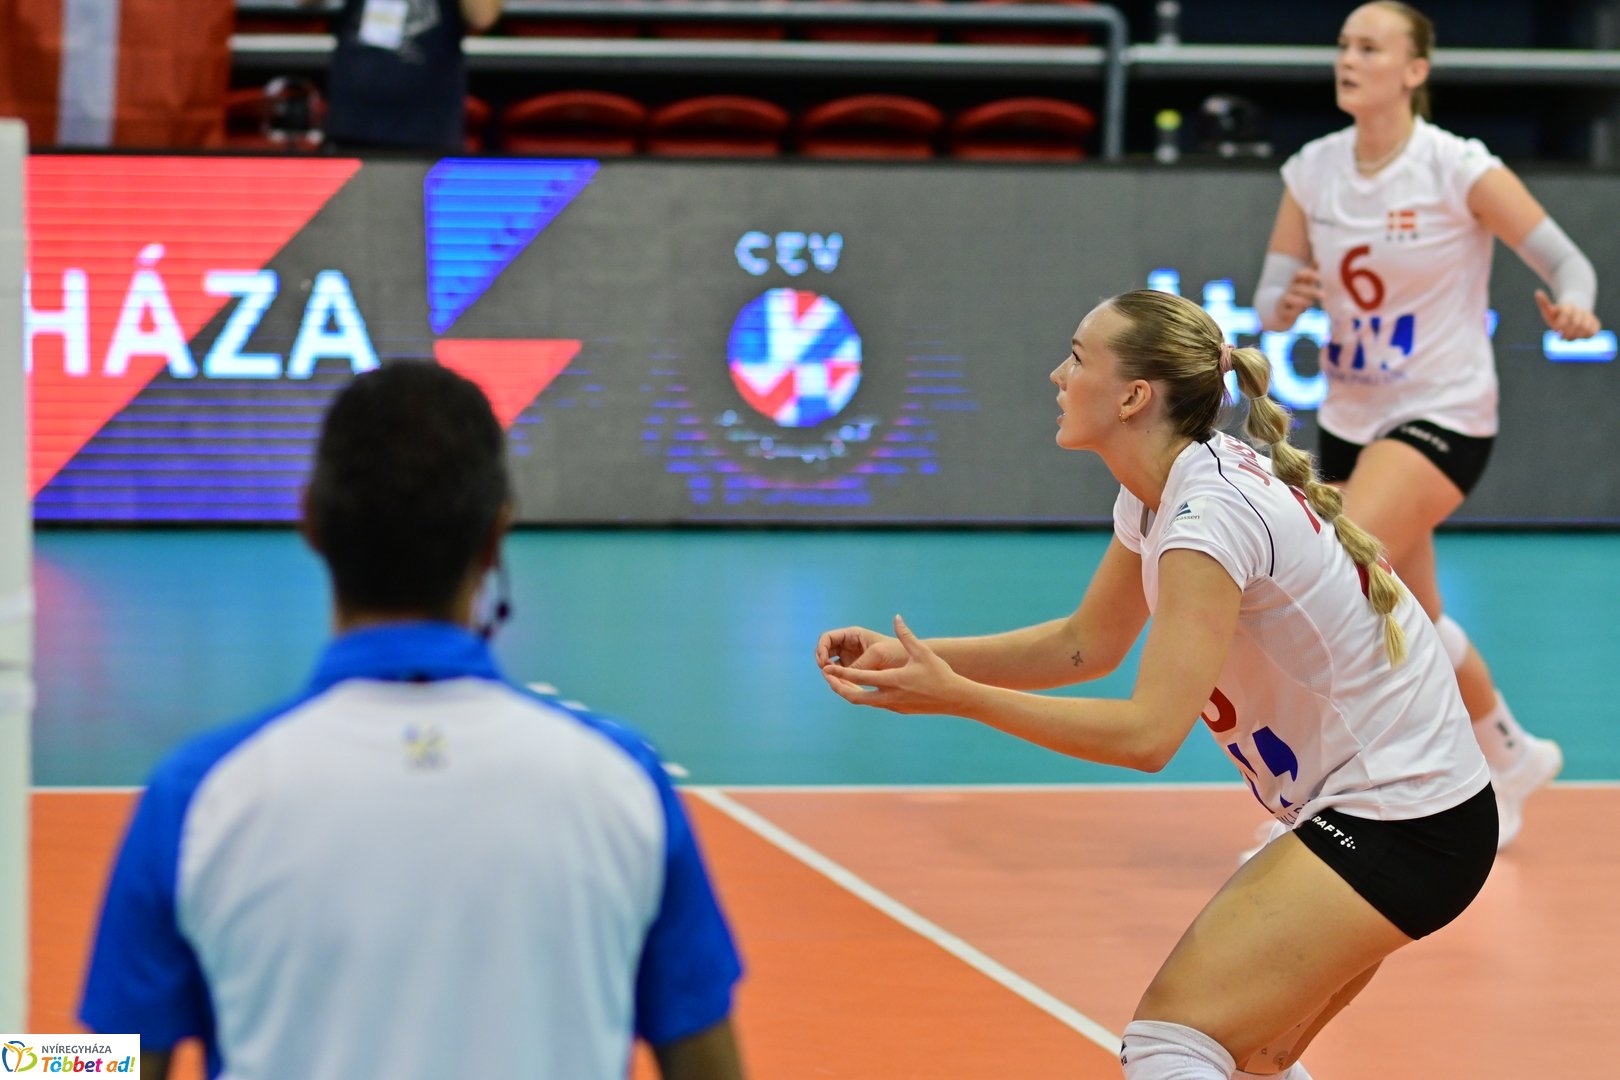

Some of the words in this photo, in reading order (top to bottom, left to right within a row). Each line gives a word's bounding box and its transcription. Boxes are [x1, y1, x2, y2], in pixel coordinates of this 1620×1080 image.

[735, 231, 844, 276] CEV
[1341, 244, 1385, 312] 6
[1311, 815, 1345, 838] RAFT
